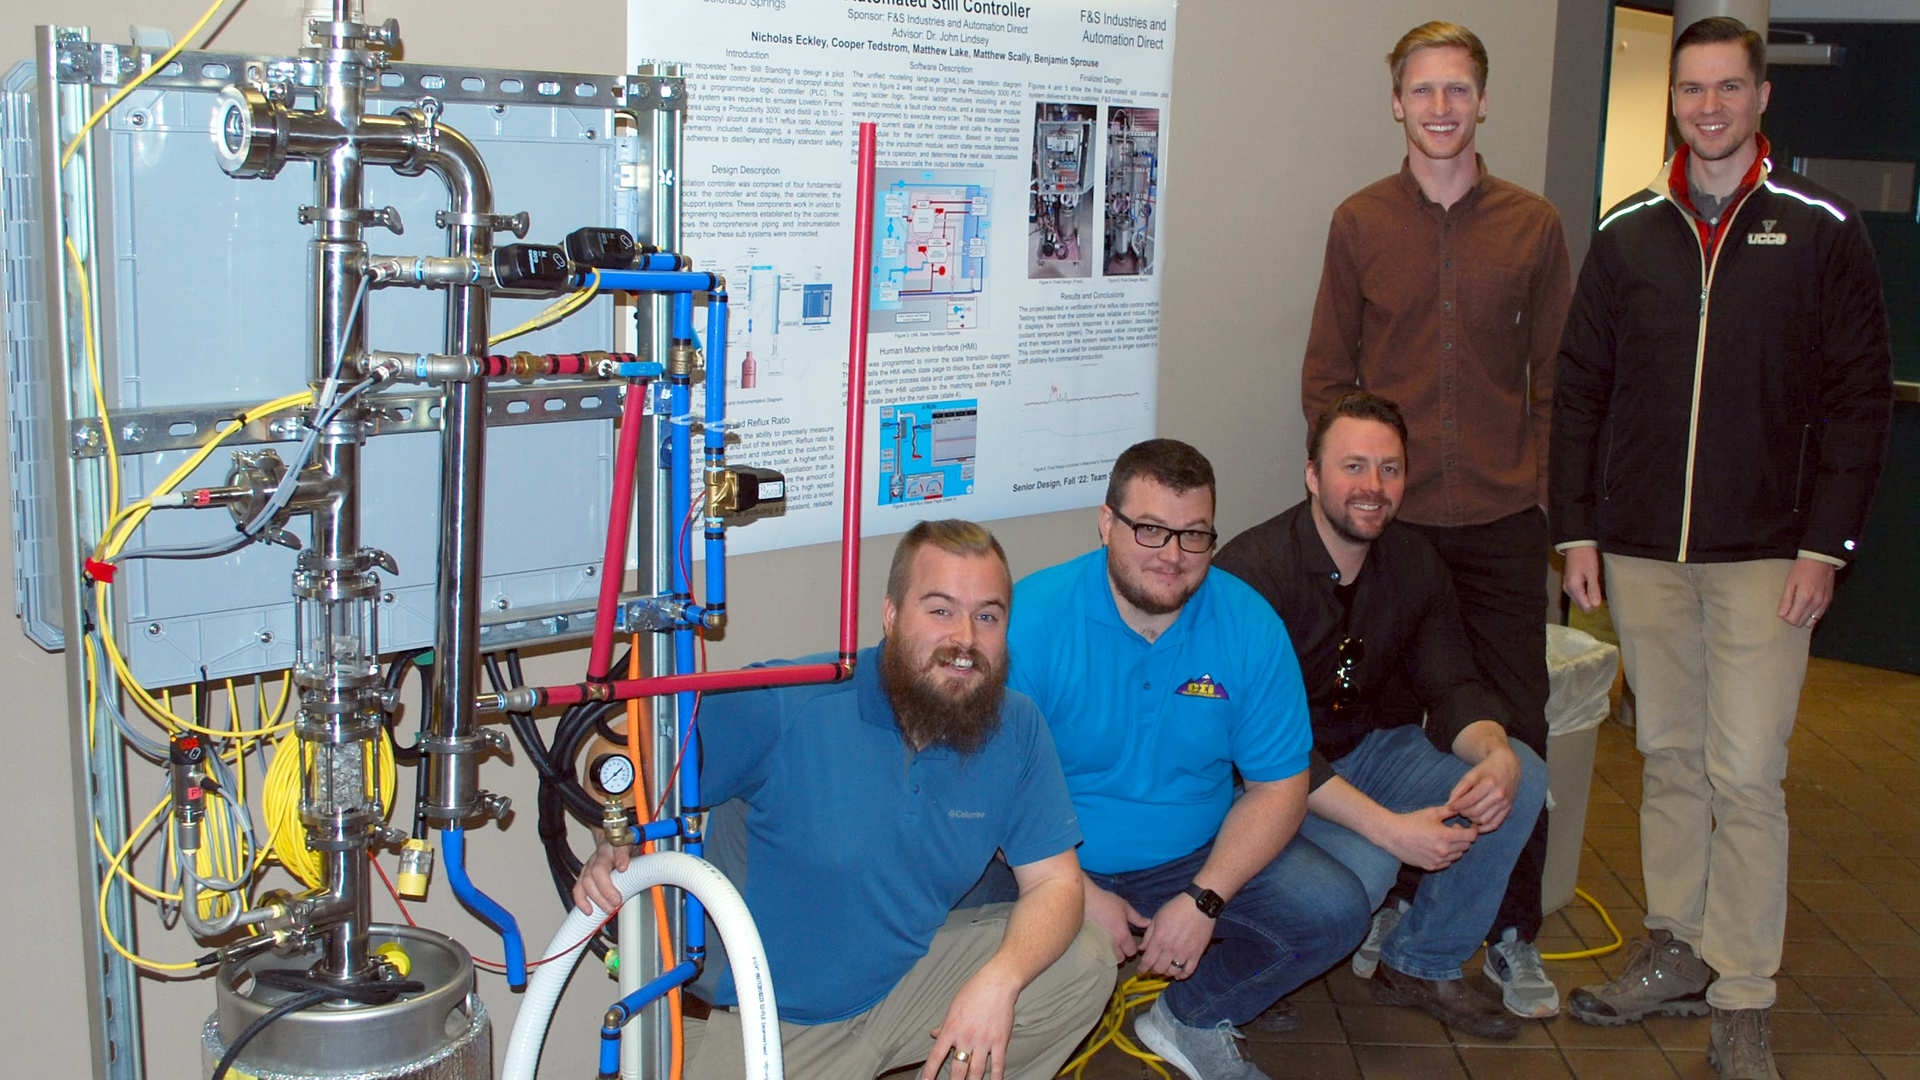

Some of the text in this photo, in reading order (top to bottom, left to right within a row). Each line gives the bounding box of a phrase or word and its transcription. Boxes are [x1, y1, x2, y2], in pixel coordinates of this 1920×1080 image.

[750, 0, 786, 11] Springs
[963, 0, 1031, 18] Controller
[847, 8, 1028, 34] Sponsor: F&S Industries and Automation Direct
[1080, 9, 1166, 31] F&S Industries and
[891, 27, 989, 47] Advisor: Dr. John Lindsey
[1081, 29, 1164, 50] Automation Direct
[725, 48, 769, 60] Introduction
[751, 31, 1099, 68] Nicholas Eckley, Cooper Tedstrom, Matthew Lake, Matthew Scally, Benjamin Sprouse
[695, 62, 727, 71] requested
[730, 63, 747, 71] Team
[750, 64, 762, 72] Still
[764, 65, 791, 76] Standing
[802, 69, 822, 78] design
[831, 70, 844, 78] pilot
[909, 60, 973, 74] Software Description
[695, 72, 708, 80] and
[752, 76, 786, 84] automation
[787, 77, 794, 85] of
[795, 79, 822, 88] isopropyl
[1079, 73, 1122, 86] Finalized Design
[716, 125, 743, 133] included
[746, 126, 782, 136] datalogging,
[794, 127, 826, 136] notification
[685, 134, 719, 142] adherence
[721, 135, 728, 143] to
[730, 135, 756, 145] distillery
[772, 137, 795, 146] industry
[797, 138, 823, 146] standard
[825, 138, 843, 148] safety
[711, 164, 780, 176] Design Description
[707, 200, 733, 209] systems.
[736, 199, 755, 207] These
[756, 201, 792, 209] components
[759, 210, 793, 218] established
[793, 210, 801, 219] by
[802, 210, 812, 218] the
[699, 220, 709, 228] the
[712, 220, 758, 229] comprehensive
[761, 221, 779, 229] piping
[782, 220, 794, 228] and
[716, 230, 734, 238] these
[735, 230, 747, 238] sub
[747, 230, 772, 239] systems
[1747, 232, 1788, 245] UCCS
[1060, 291, 1125, 300] Results and Conclusions
[879, 342, 978, 355] Human Machine Interface (HMI)
[867, 369, 879, 377] tells
[931, 366, 945, 374] page
[952, 364, 970, 372] display.
[971, 362, 985, 370] Each
[998, 362, 1012, 372] page
[874, 378, 898, 387] pertinent
[898, 377, 919, 385] process
[932, 374, 943, 382] and
[955, 373, 975, 381] options.
[1000, 369, 1012, 377] PLC
[746, 415, 790, 427] Reflux Ratio
[755, 430, 772, 439] ability
[782, 427, 808, 438] precisely
[1012, 482, 1036, 492] Senior
[1036, 479, 1062, 489] Design,
[1063, 476, 1076, 486] Fall
[1077, 474, 1089, 484] '22:
[1090, 473, 1107, 482] Team
